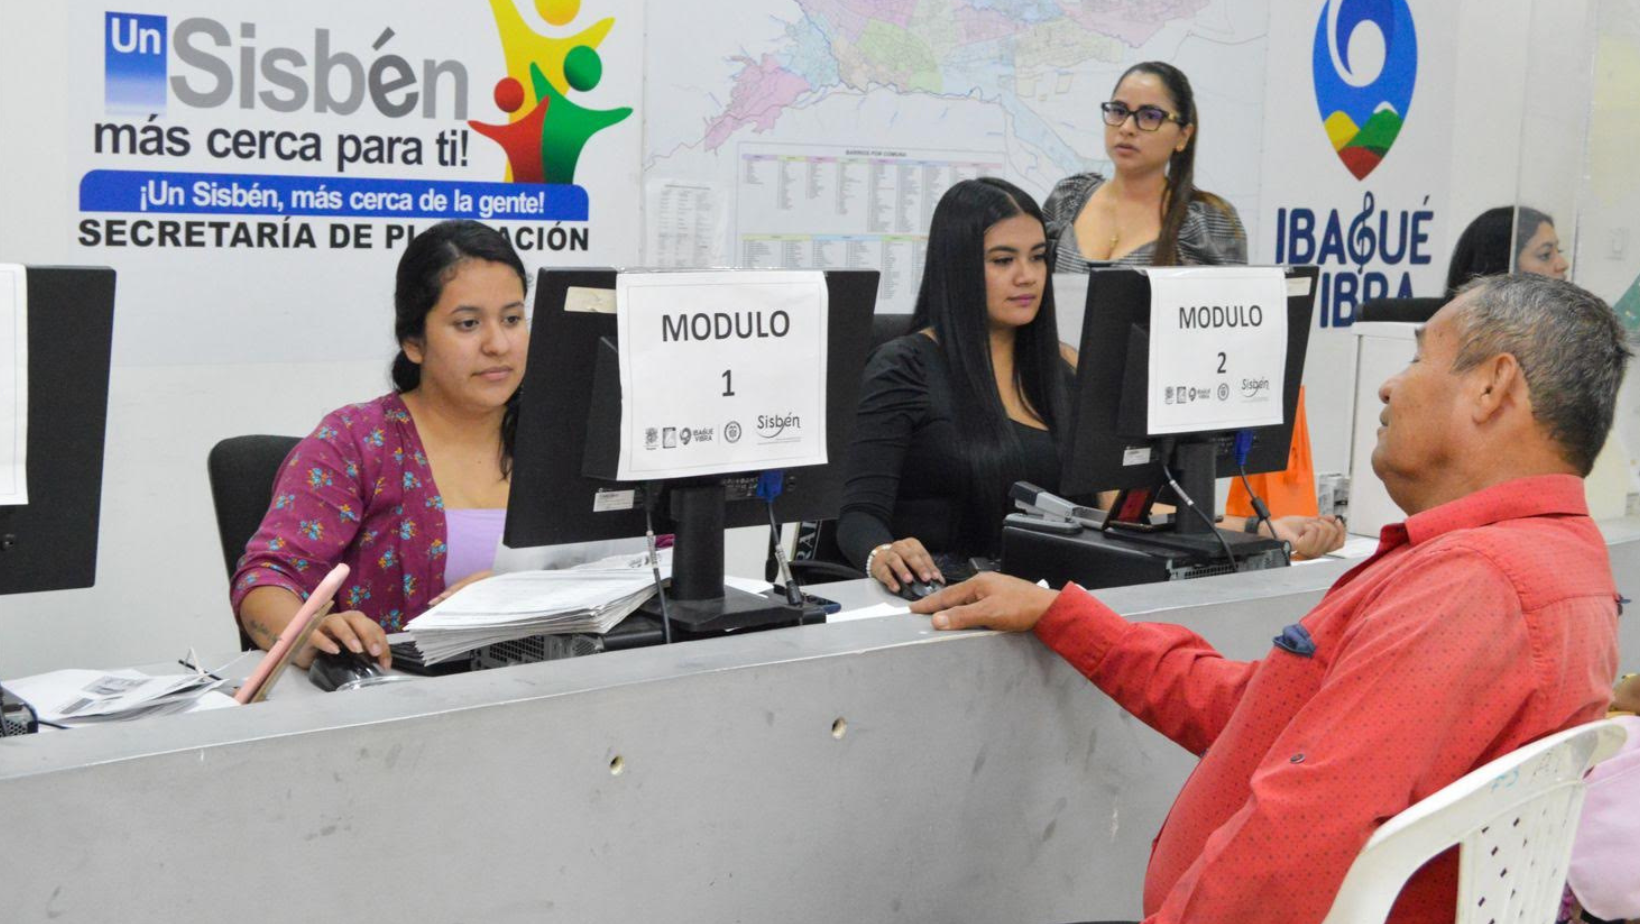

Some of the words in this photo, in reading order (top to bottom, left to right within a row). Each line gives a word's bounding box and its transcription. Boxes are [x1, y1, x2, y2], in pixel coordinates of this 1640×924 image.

[111, 17, 161, 54] Un
[170, 17, 469, 120] Sisbén
[94, 114, 191, 157] más
[206, 128, 322, 162] cerca
[337, 133, 423, 173] para
[436, 129, 469, 167] ti!
[140, 182, 185, 208] ¡Un
[192, 182, 284, 211] Sisbén,
[291, 184, 343, 210] más
[349, 191, 413, 211] cerca
[418, 188, 448, 212] de
[453, 190, 473, 213] la
[478, 191, 545, 218] gente!
[78, 216, 317, 249] SECRETARÍA
[329, 223, 373, 249] DE
[1275, 191, 1434, 274] IBAGUÉ
[662, 310, 790, 342] MODULO
[1179, 304, 1263, 329] MODULO
[1216, 352, 1227, 374] 2
[722, 369, 735, 397] 1
[757, 411, 801, 430] Sisbén
